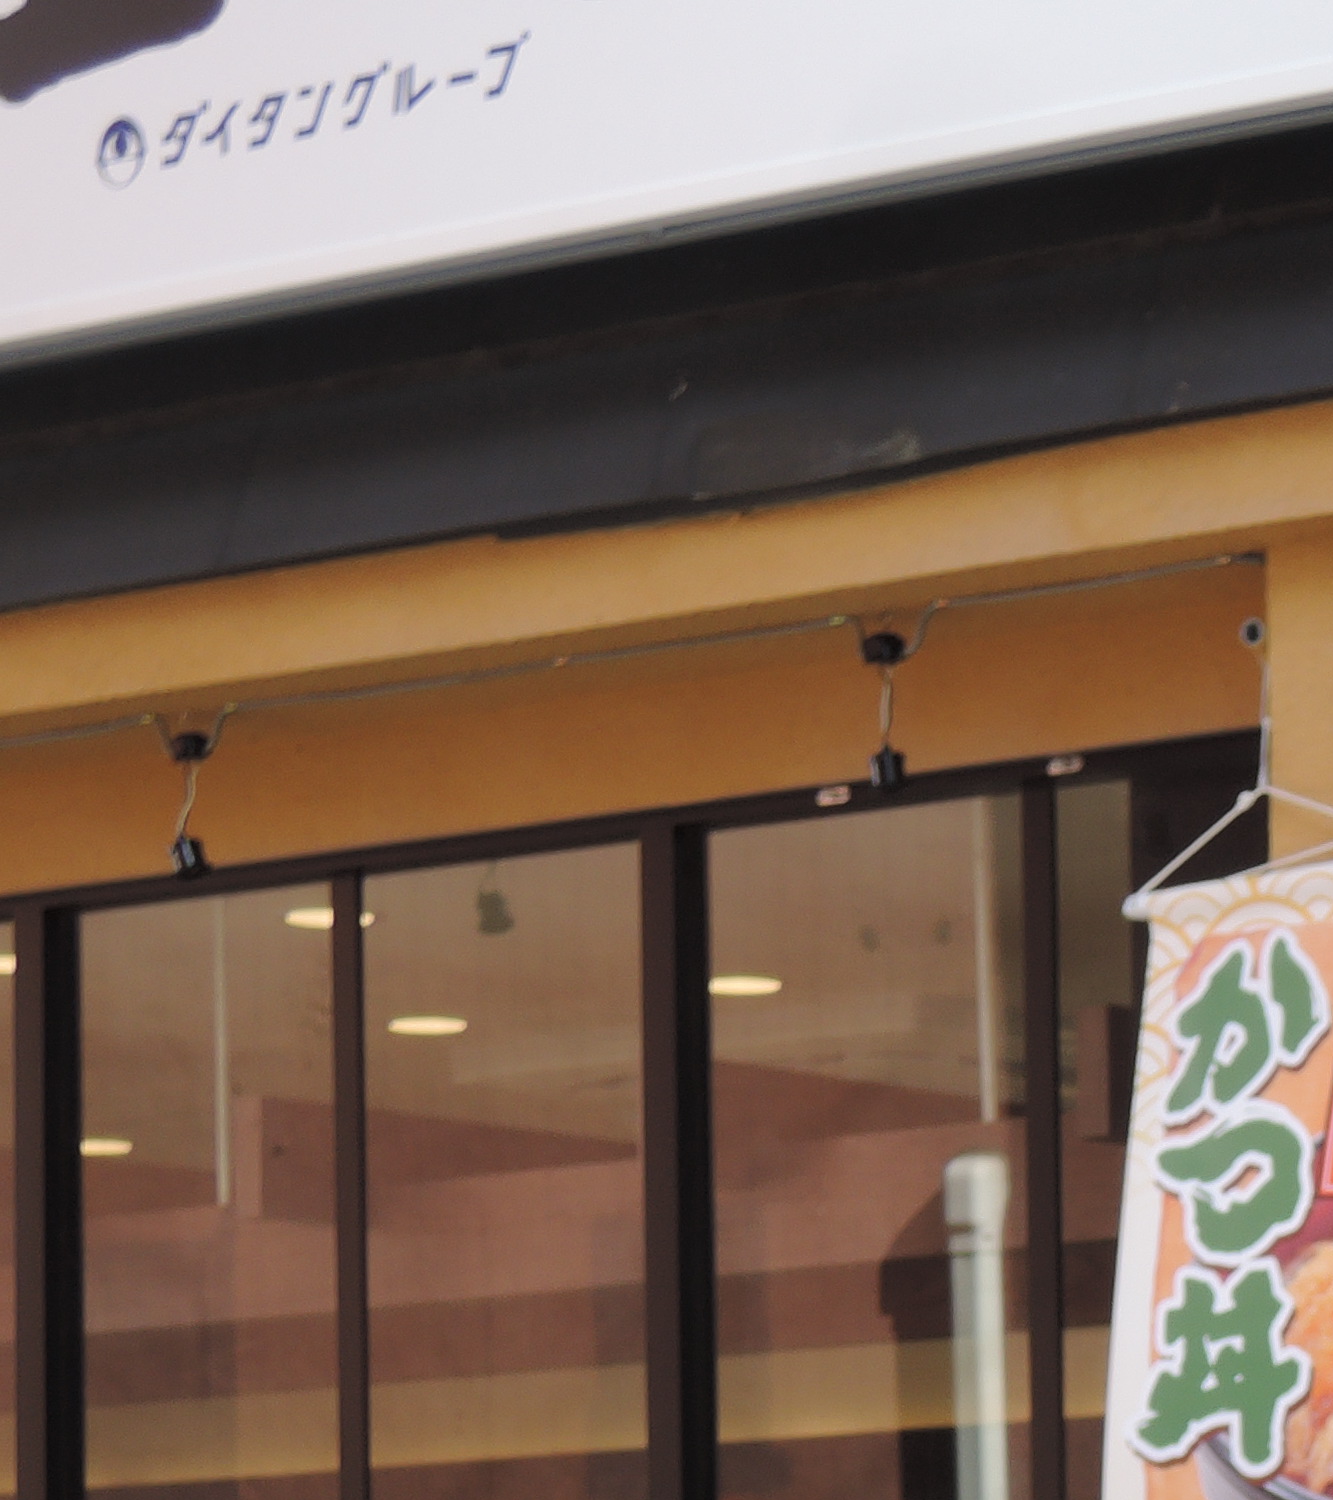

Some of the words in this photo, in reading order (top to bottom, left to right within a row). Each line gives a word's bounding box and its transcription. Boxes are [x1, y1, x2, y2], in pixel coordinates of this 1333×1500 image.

[159, 29, 531, 169] ダイタングループ
[1131, 930, 1332, 1480] かつ丼
